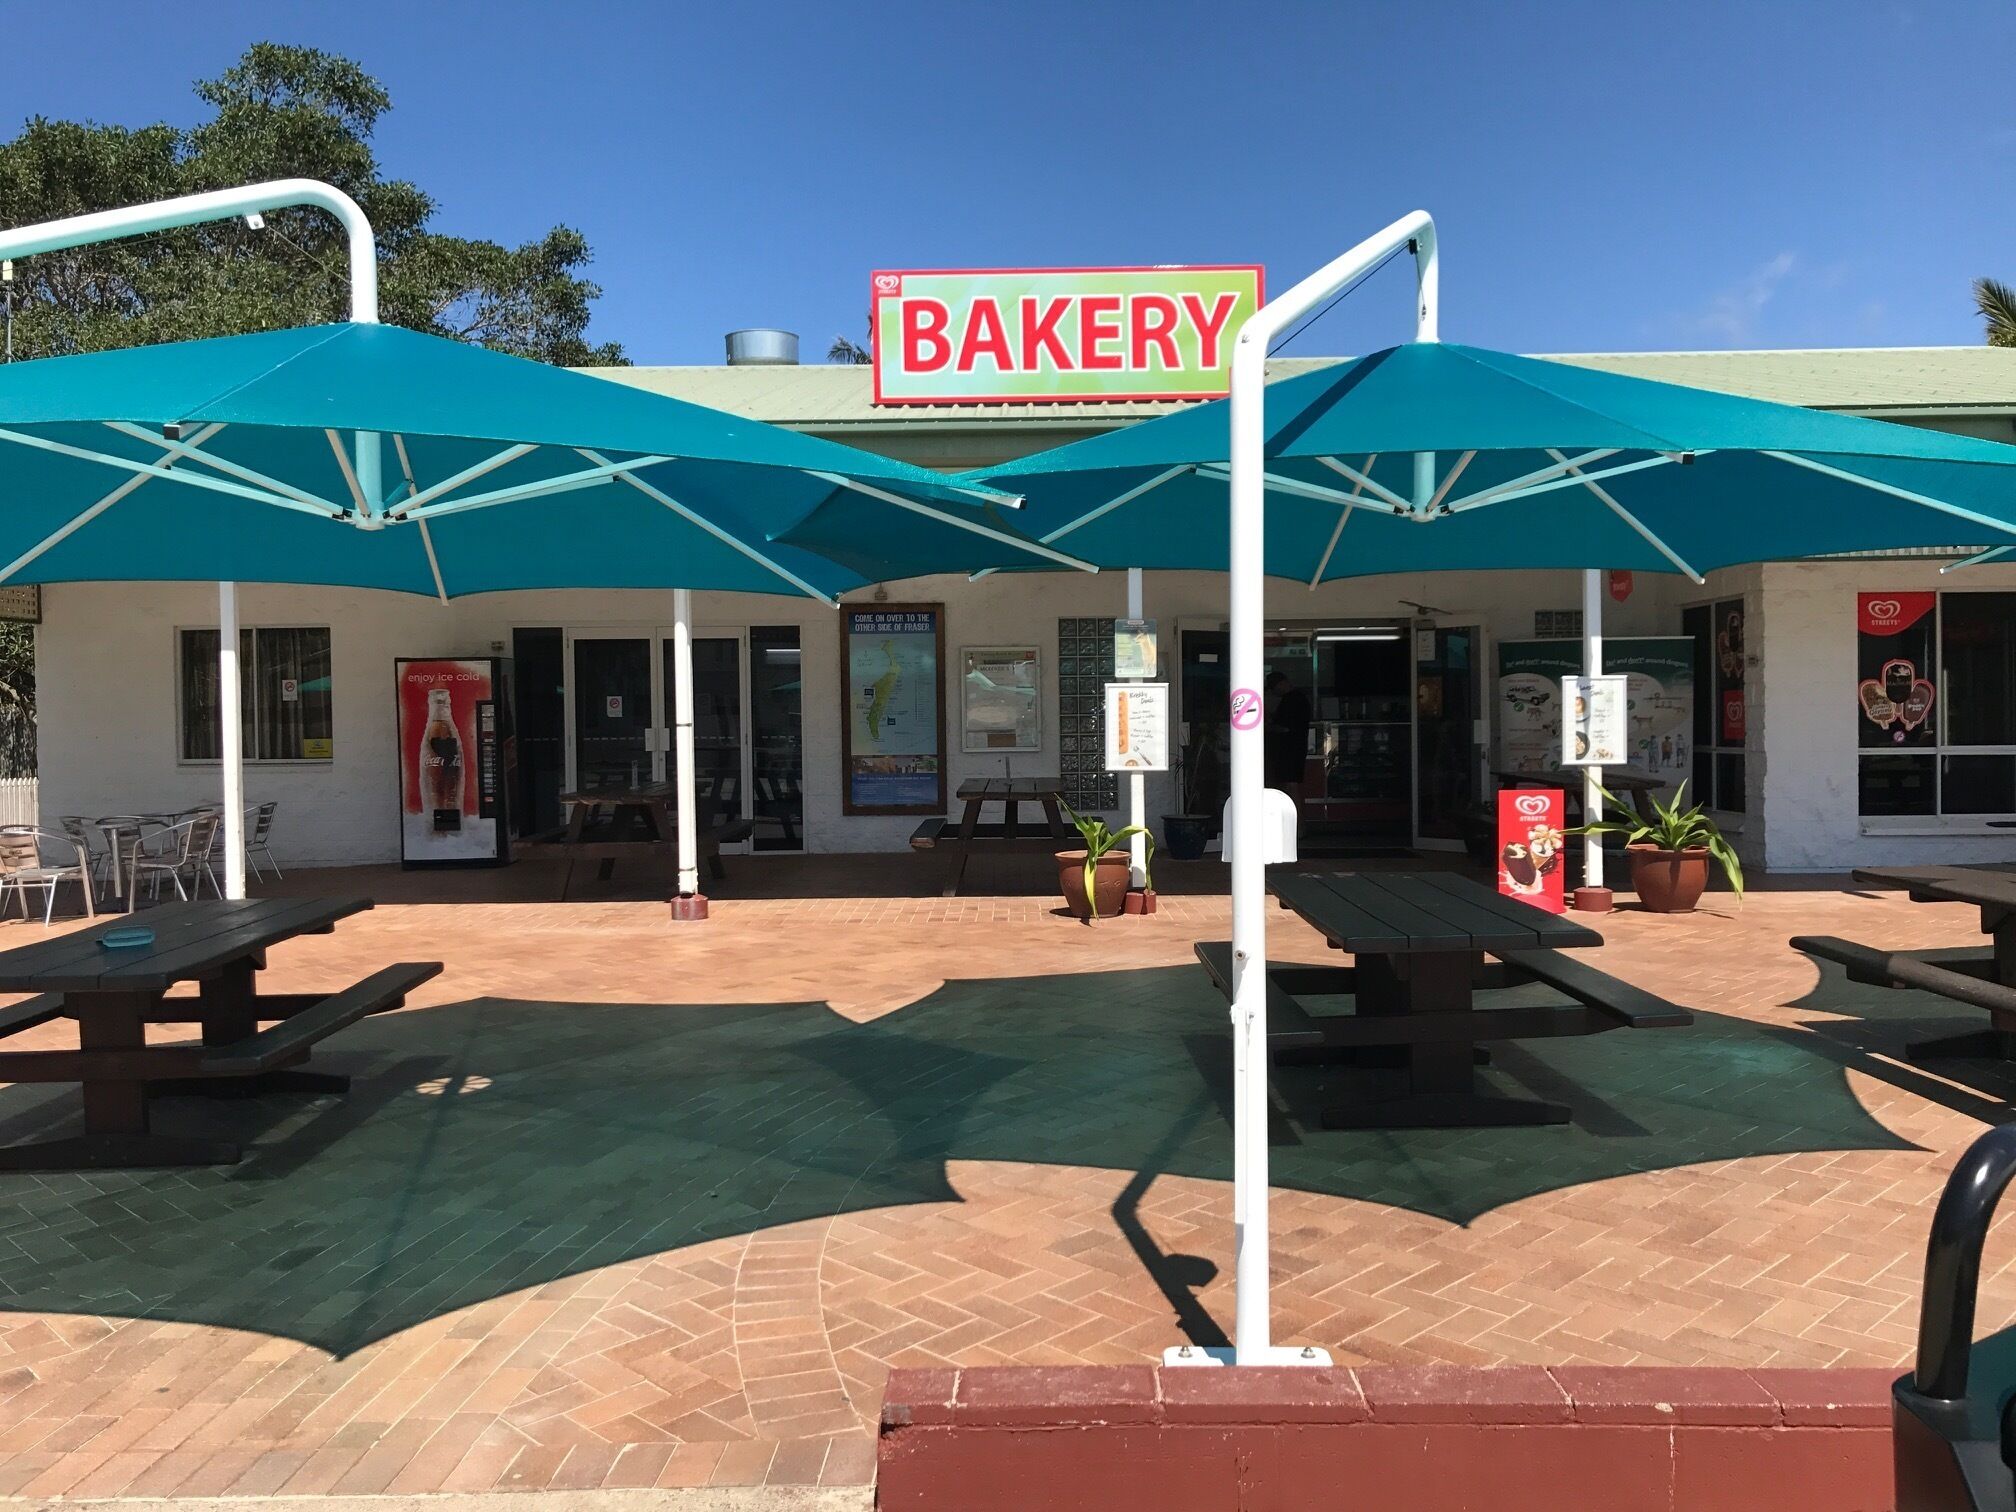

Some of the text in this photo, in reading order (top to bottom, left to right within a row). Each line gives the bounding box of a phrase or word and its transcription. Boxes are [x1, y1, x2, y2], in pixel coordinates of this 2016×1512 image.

[902, 293, 1240, 374] BAKERY
[855, 613, 930, 622] COME ON OVER TO THE
[855, 623, 930, 632] OTHER SIDE OF FRASER
[408, 672, 481, 683] enjoy ice cold
